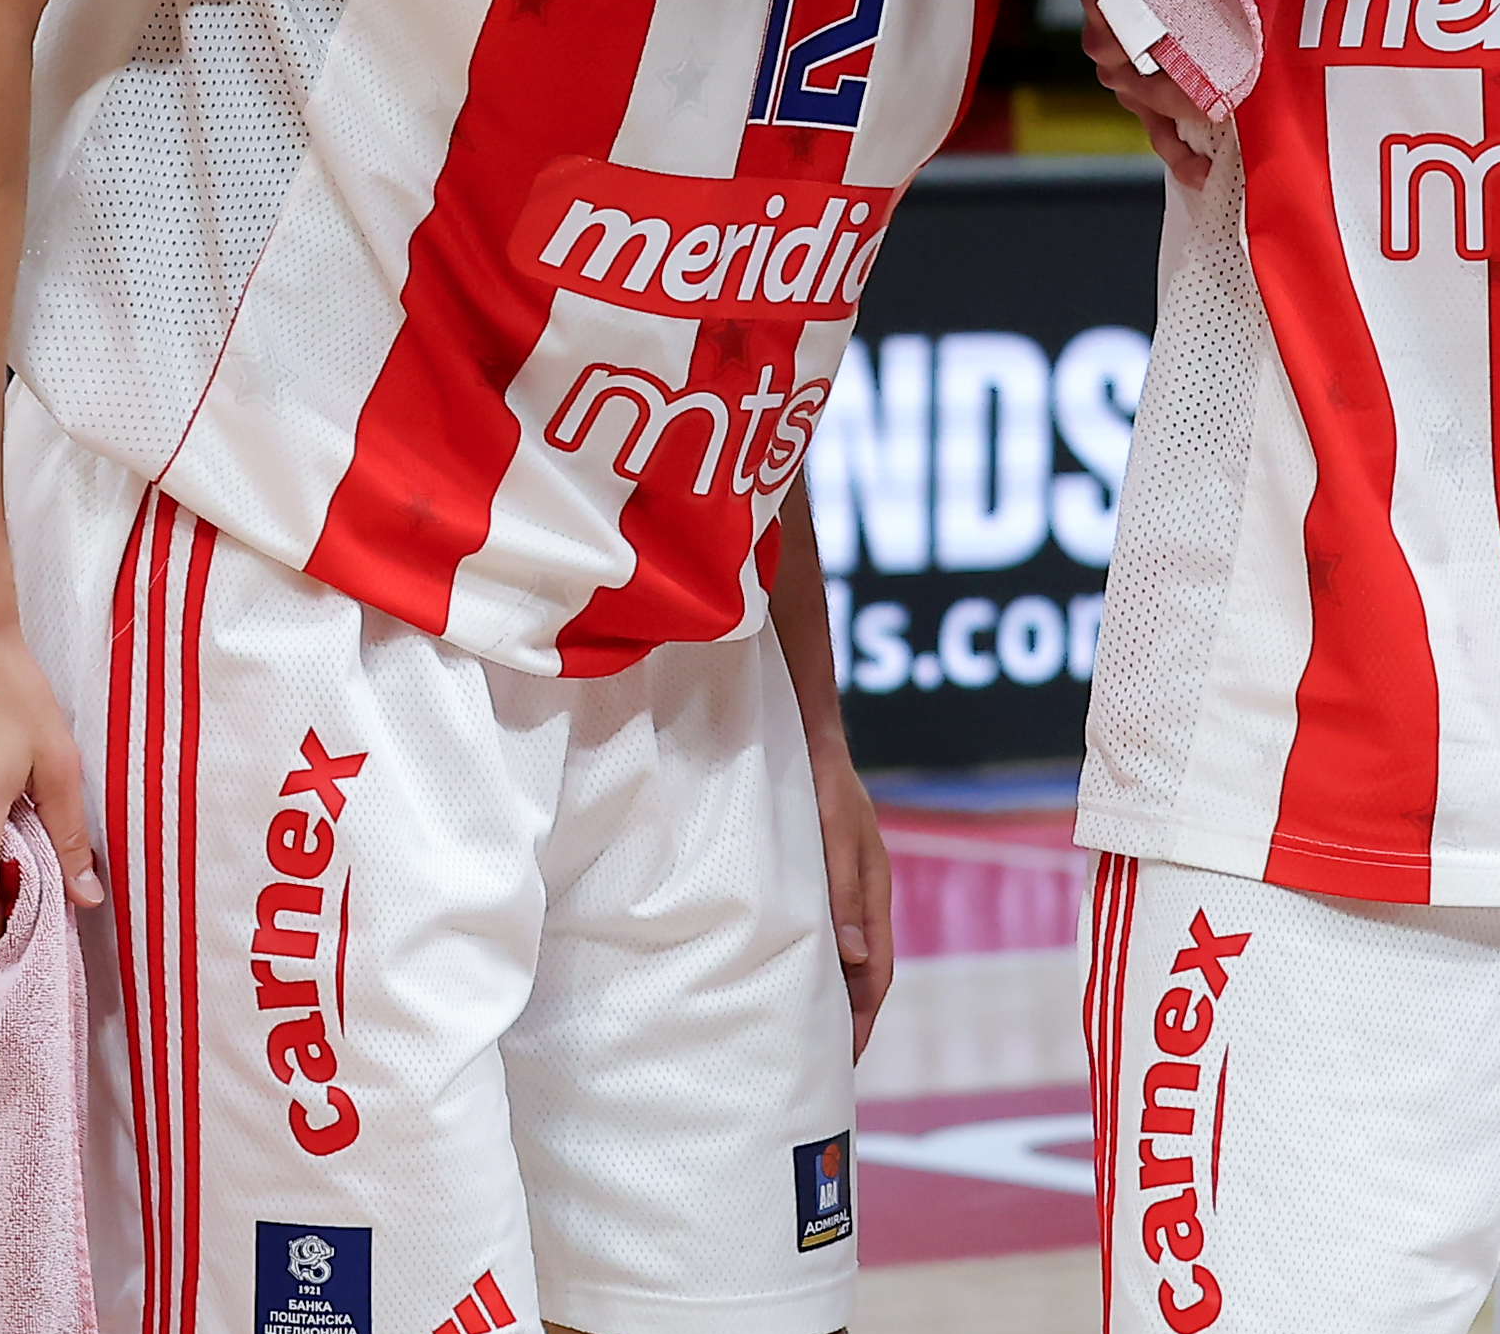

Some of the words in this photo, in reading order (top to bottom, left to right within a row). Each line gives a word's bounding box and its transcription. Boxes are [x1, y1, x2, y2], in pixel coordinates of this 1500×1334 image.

[545, 363, 830, 497] mts
[250, 726, 369, 1156] carnex
[804, 1208, 850, 1236] ADMIRAL
[299, 1285, 322, 1296] 1921
[288, 1299, 333, 1312] БАНКА
[269, 1310, 353, 1325] ПОШТАНСКА
